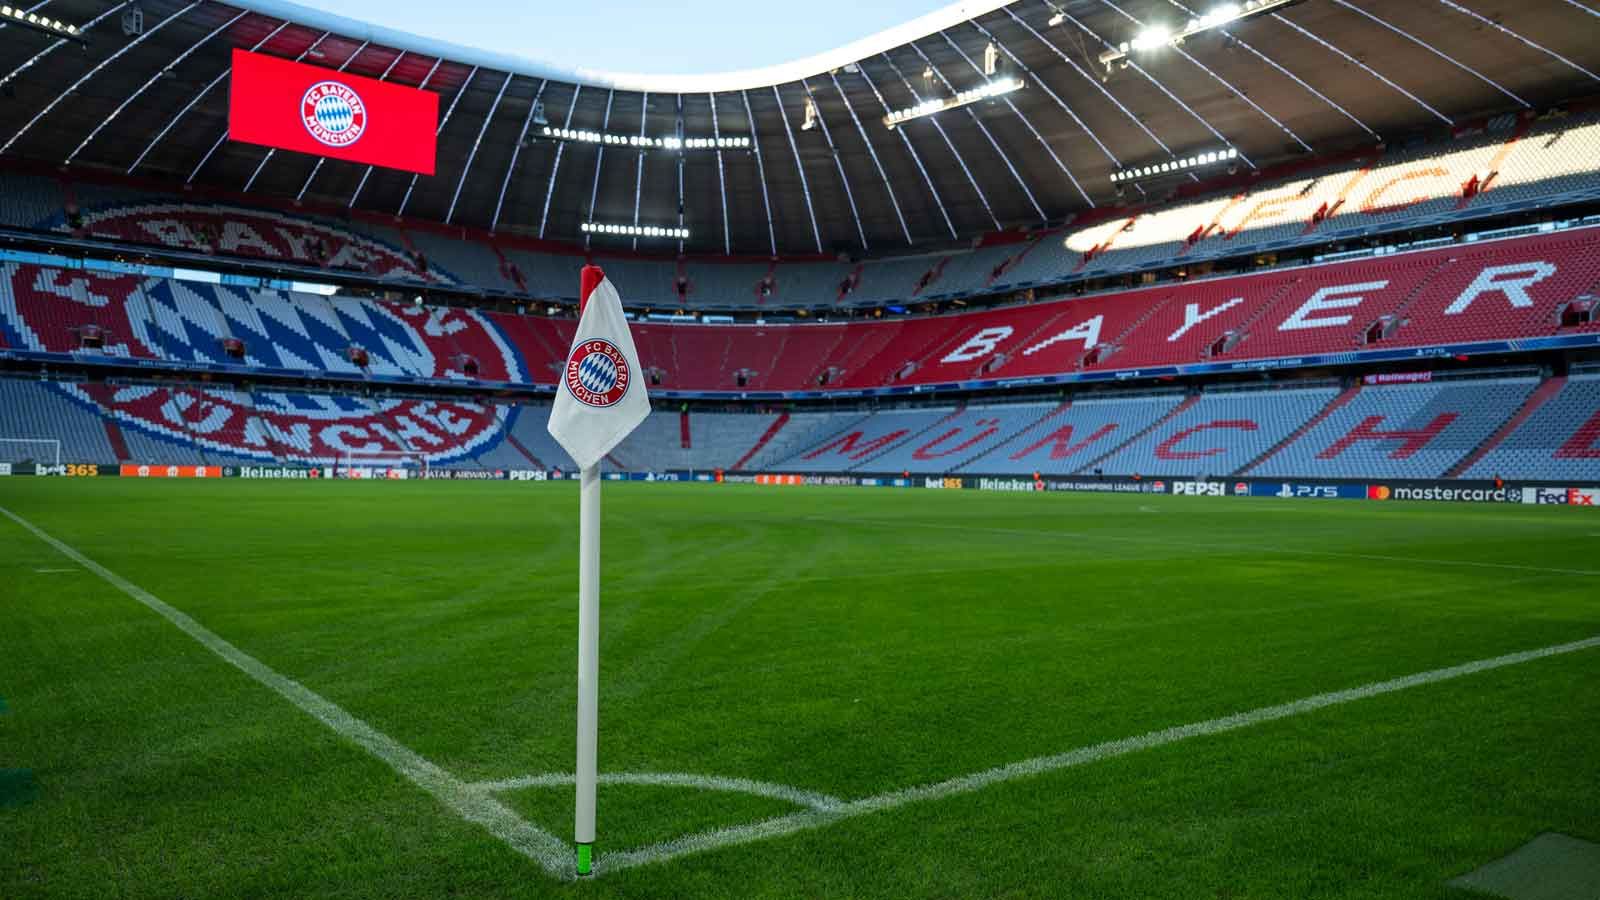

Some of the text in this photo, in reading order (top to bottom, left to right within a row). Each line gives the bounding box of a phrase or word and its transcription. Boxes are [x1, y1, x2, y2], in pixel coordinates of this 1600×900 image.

[306, 85, 362, 115] FC BAYERN
[941, 261, 1557, 362] BAYER
[585, 342, 627, 391] FC BAYERN
[240, 467, 307, 479] Heineken
[510, 470, 547, 480] PEPSI
[925, 477, 962, 489] bet365
[980, 478, 1034, 491] Heineken
[1172, 481, 1226, 496] PEPSI
[1297, 486, 1337, 497] PS5
[1394, 486, 1505, 501] mastercard
[1535, 488, 1594, 504] FedEx
